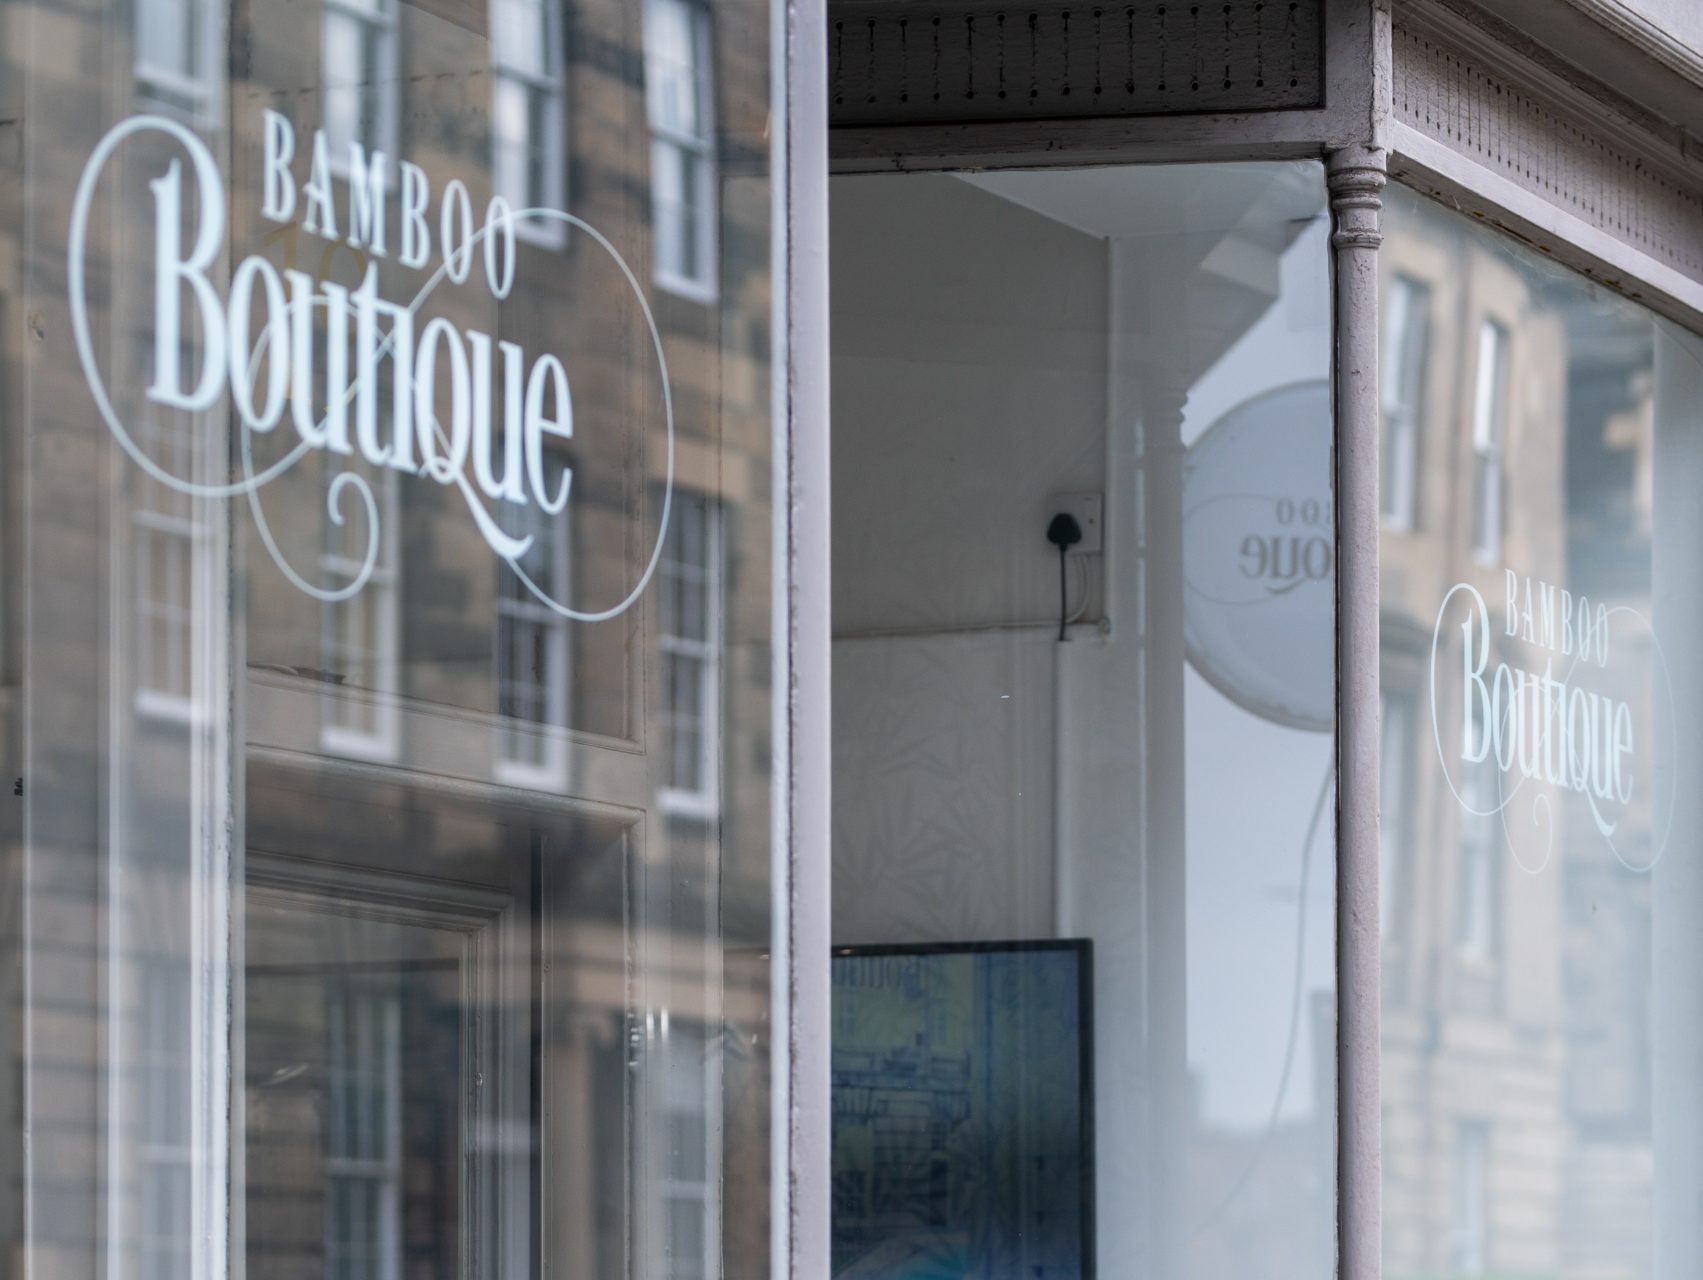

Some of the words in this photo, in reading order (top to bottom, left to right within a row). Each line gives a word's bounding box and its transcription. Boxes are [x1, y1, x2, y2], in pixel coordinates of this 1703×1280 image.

[261, 108, 516, 300] BAMBOO
[146, 115, 574, 560] Boutique
[1461, 583, 1634, 837] Boutique
[1504, 567, 1609, 668] BAMBOO
